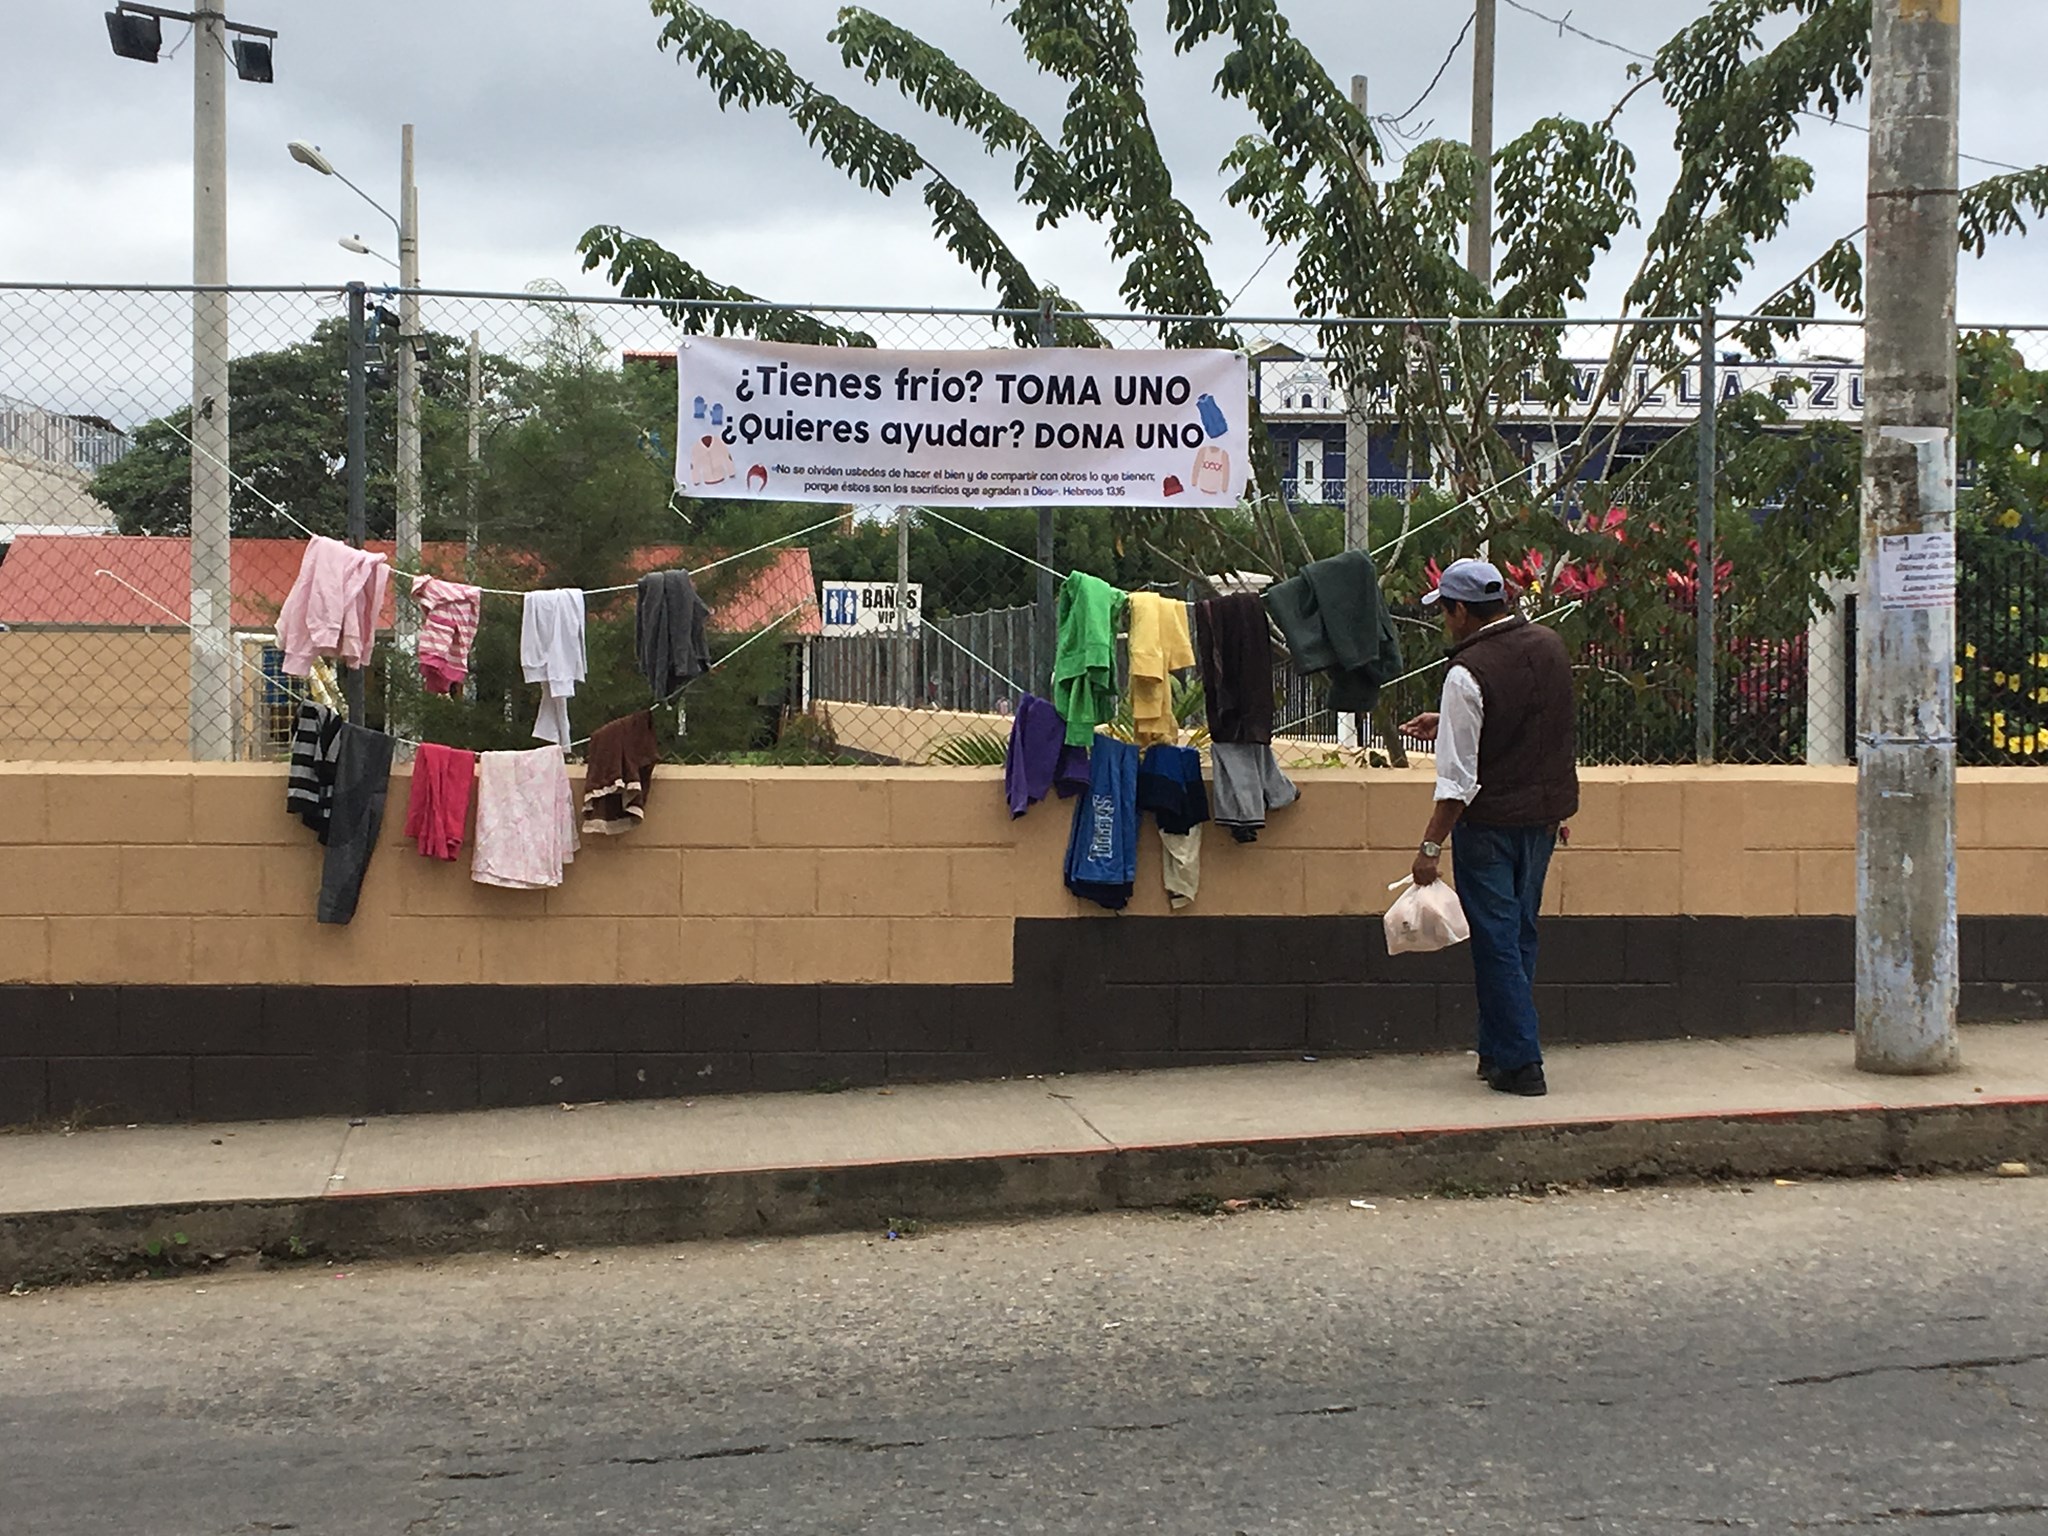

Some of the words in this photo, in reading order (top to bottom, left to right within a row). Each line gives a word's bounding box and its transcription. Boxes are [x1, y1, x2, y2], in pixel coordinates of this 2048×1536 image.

[736, 362, 882, 401] ¿Tienes
[895, 367, 983, 402] frío?
[995, 374, 1101, 405] TOMA
[1114, 375, 1191, 405] UNO
[721, 410, 870, 444] ¿Quieres
[881, 418, 1025, 453] ayudar?
[1035, 422, 1124, 449] DONA
[1136, 423, 1204, 449] UNO
[793, 466, 805, 475] se
[807, 464, 843, 476] olviden
[845, 466, 887, 478] ustedes
[888, 467, 901, 478] de
[903, 467, 931, 479] hacer
[933, 468, 942, 479] el
[944, 468, 965, 480] bien
[967, 472, 974, 482] y
[976, 471, 989, 481] de
[990, 471, 1037, 483] compartir
[1040, 472, 1058, 481] con
[1060, 471, 1087, 481] otros
[1089, 471, 1099, 481] lo
[1100, 473, 1118, 484] que
[804, 482, 839, 494] porque
[841, 481, 871, 493] éstos
[873, 484, 891, 493] son
[893, 483, 908, 494] los
[910, 483, 959, 495] sacrificios
[961, 487, 979, 497] que
[982, 486, 1021, 497] agradan
[1023, 488, 1029, 496] a
[1063, 486, 1104, 496] Hebreos
[862, 585, 917, 609] BAÑS
[878, 611, 895, 624] VIP
